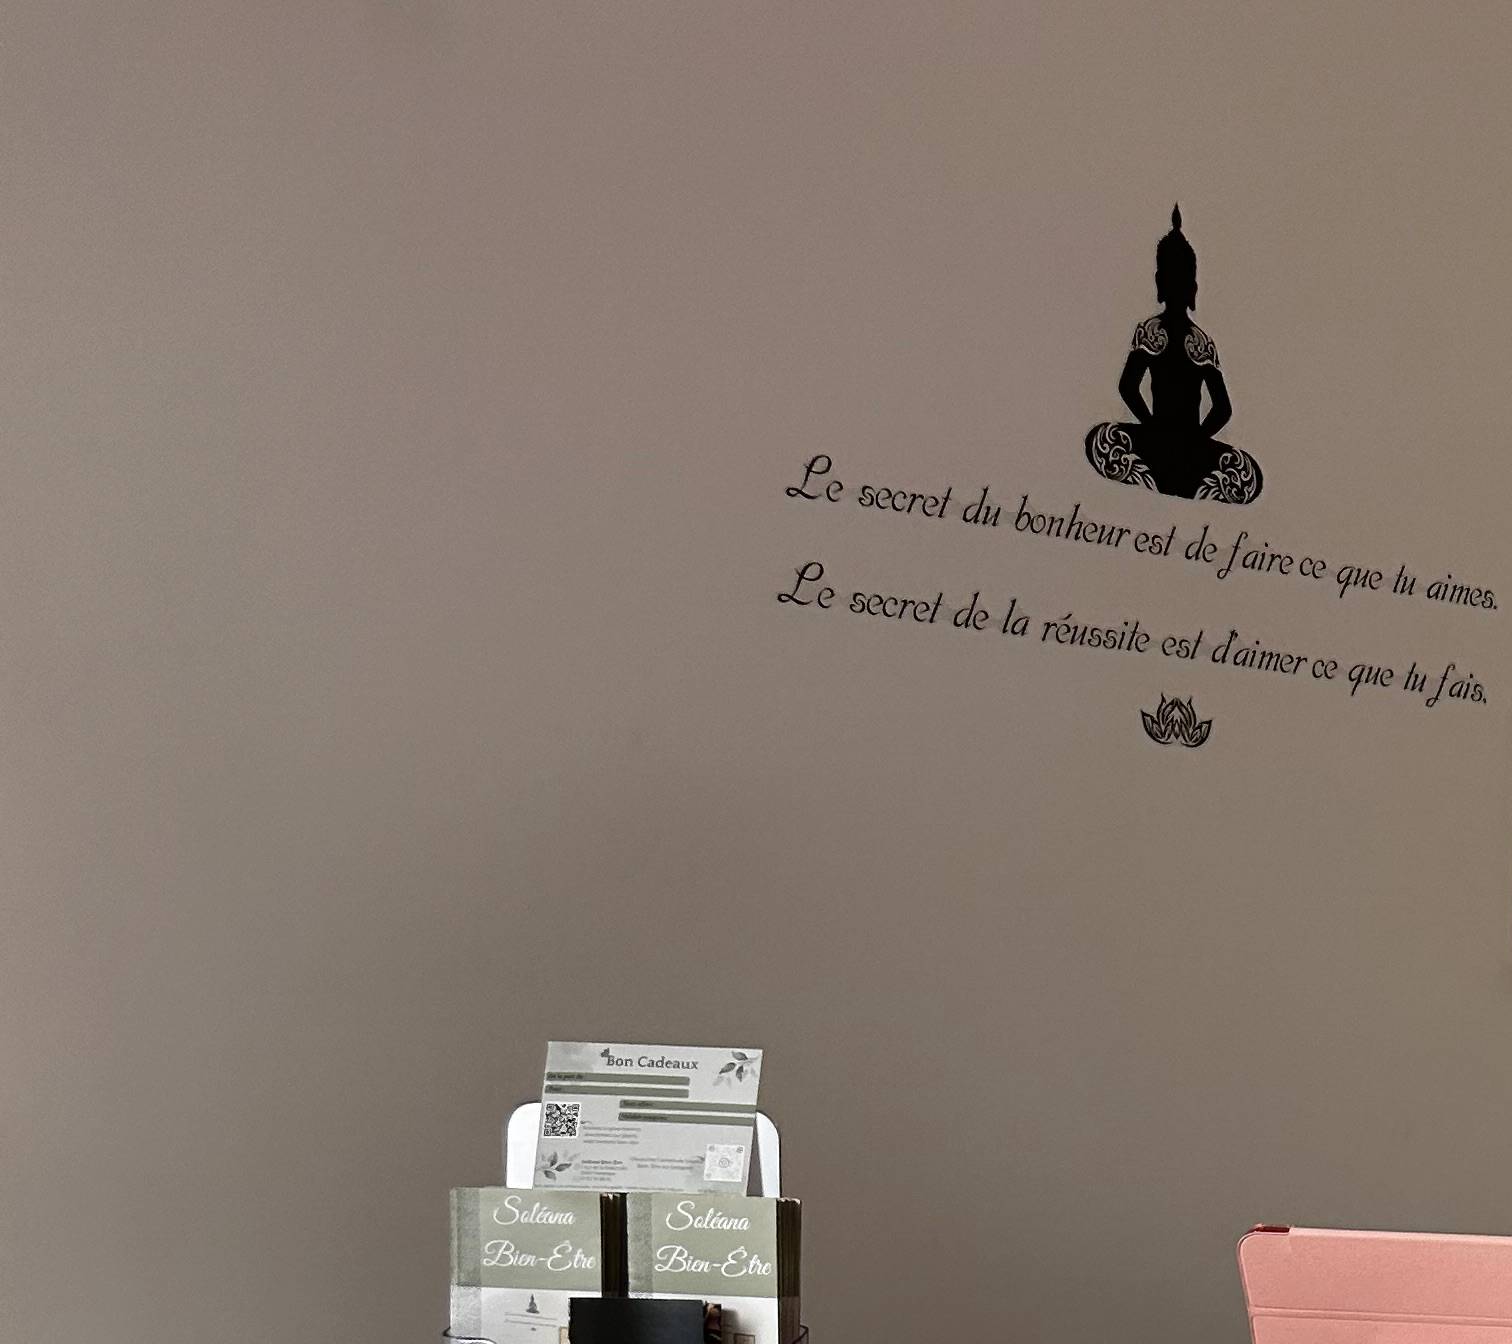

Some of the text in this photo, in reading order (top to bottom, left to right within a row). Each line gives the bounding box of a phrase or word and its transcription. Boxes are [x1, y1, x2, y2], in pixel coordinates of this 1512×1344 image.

[785, 454, 1498, 610] Le secret du bonheur est de faire ce que tu aimes.
[777, 561, 1487, 708] Le secret de la réussite est d'aimer ce que tu fais.
[606, 1055, 699, 1070] Bon Cadeaux
[493, 1195, 577, 1226] Soléana
[666, 1200, 751, 1231] Soléana
[483, 1239, 597, 1272] Bien-Être
[654, 1245, 772, 1277] Bien-Être
